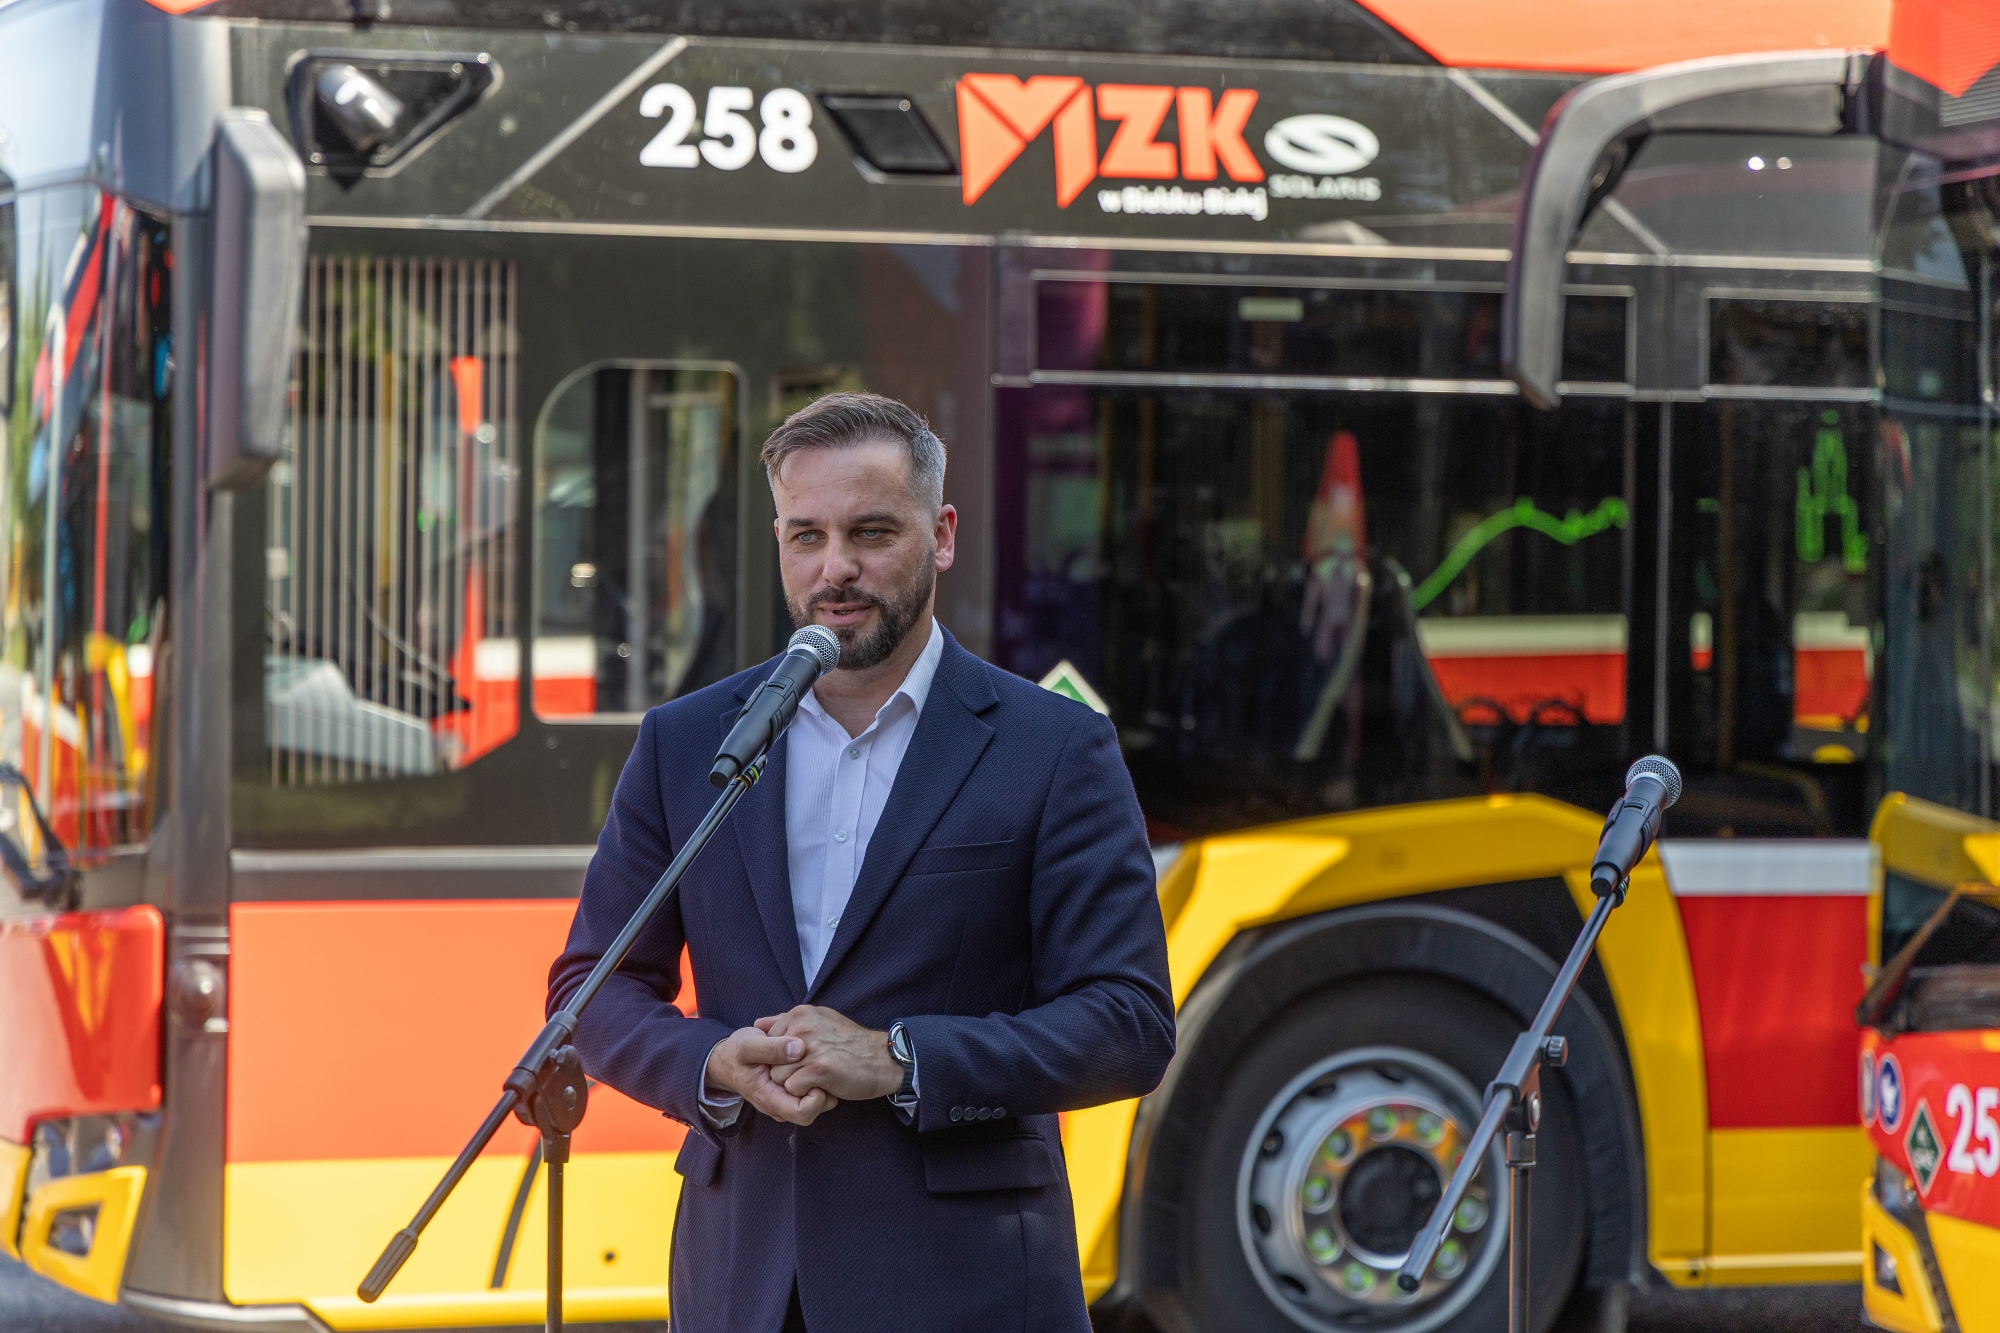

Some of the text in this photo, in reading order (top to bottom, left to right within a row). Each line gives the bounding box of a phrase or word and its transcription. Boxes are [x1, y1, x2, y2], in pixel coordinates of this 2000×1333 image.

[639, 82, 818, 173] 258
[956, 72, 1265, 209] MZK
[1268, 174, 1381, 201] SOLARIS
[1945, 1083, 2000, 1178] 25
